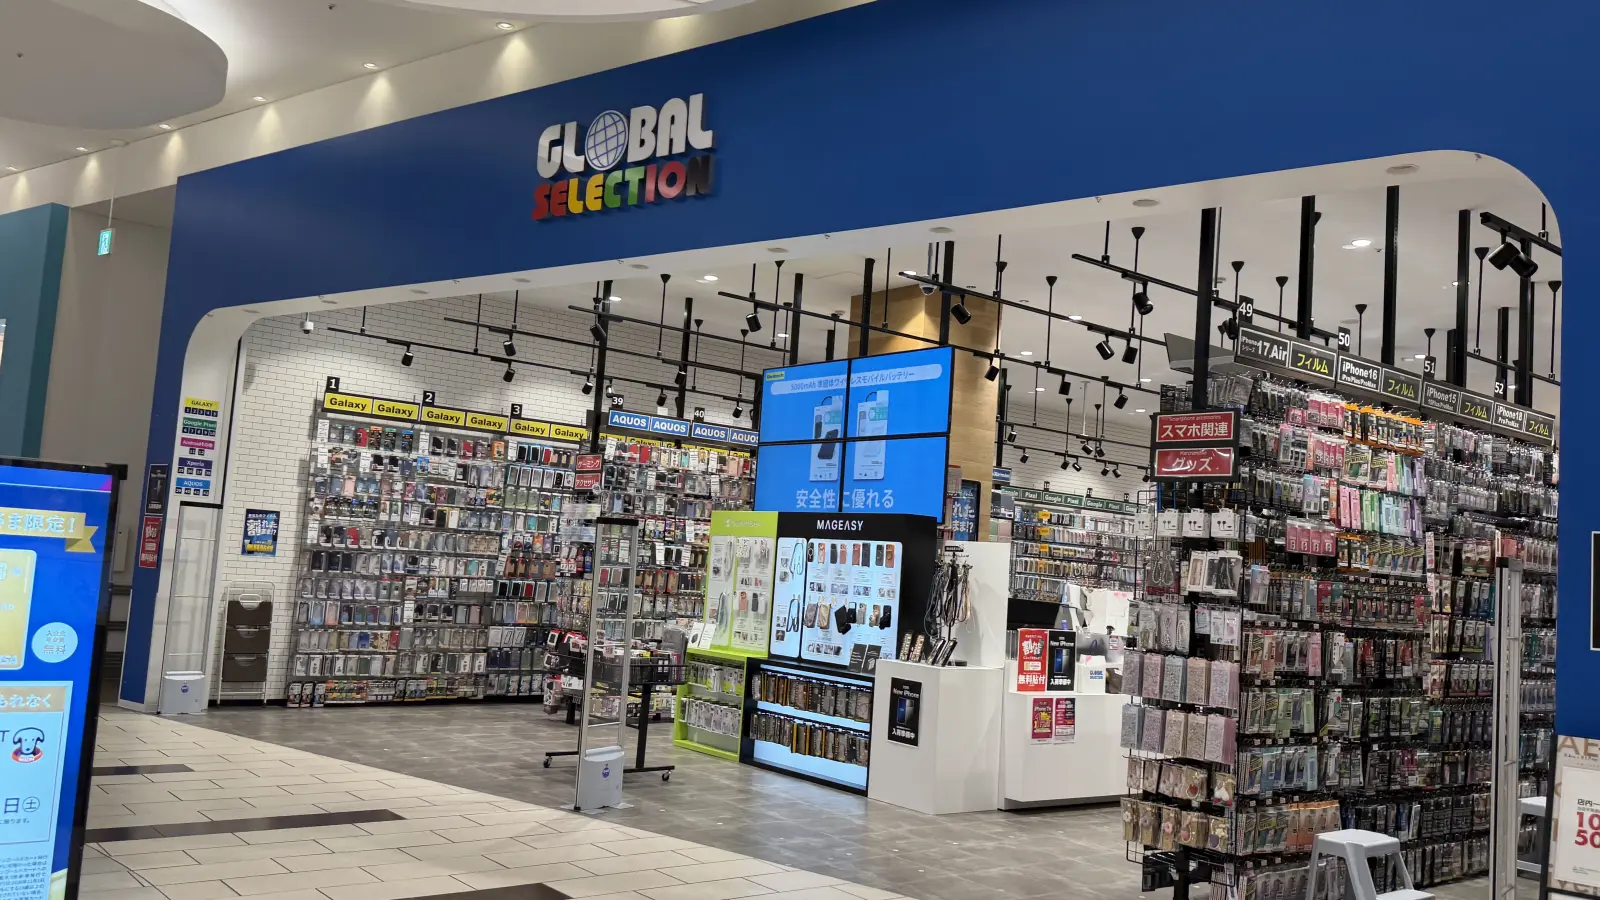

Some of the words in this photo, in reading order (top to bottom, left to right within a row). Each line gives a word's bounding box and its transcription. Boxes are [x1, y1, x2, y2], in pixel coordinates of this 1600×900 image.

[537, 93, 713, 178] GLOBAL
[532, 155, 713, 221] SELECTION
[1239, 302, 1253, 316] 49
[1338, 333, 1350, 347] 50
[1297, 353, 1329, 374] フィルム
[1342, 361, 1378, 380] iPhone16
[1424, 361, 1435, 374] 51
[329, 379, 337, 389] 1
[1387, 379, 1415, 398] フィルム
[1494, 381, 1504, 395] 52
[425, 392, 434, 403] 2
[612, 396, 624, 405] 39
[1426, 386, 1457, 404] iPhone15
[191, 400, 213, 408] GALAXY
[329, 397, 367, 411] Galaxy
[377, 402, 414, 417] Galaxy
[512, 405, 520, 415] 3
[1465, 402, 1488, 419] フィルム
[426, 409, 462, 424] Galaxy
[470, 416, 503, 430] Galaxy
[694, 409, 705, 418] 40
[183, 419, 203, 427] Google
[612, 414, 647, 427] AQUOS
[653, 420, 686, 433] AQUOS
[1161, 422, 1229, 438] スマホ関連
[1529, 420, 1549, 436] フィルム
[514, 422, 546, 435] Galaxy
[554, 427, 584, 440] Galaxy
[694, 426, 726, 438] AQUOS
[1172, 457, 1213, 472] グッズ
[1025, 491, 1038, 499] Pixel
[1045, 494, 1062, 502] Google
[1066, 497, 1079, 505] Pixel
[1086, 500, 1103, 508] Google
[816, 519, 864, 531] MAGEASY
[43, 645, 66, 655] 無料
[1018, 674, 1046, 685] 無料貼付
[903, 689, 920, 699] iPhone
